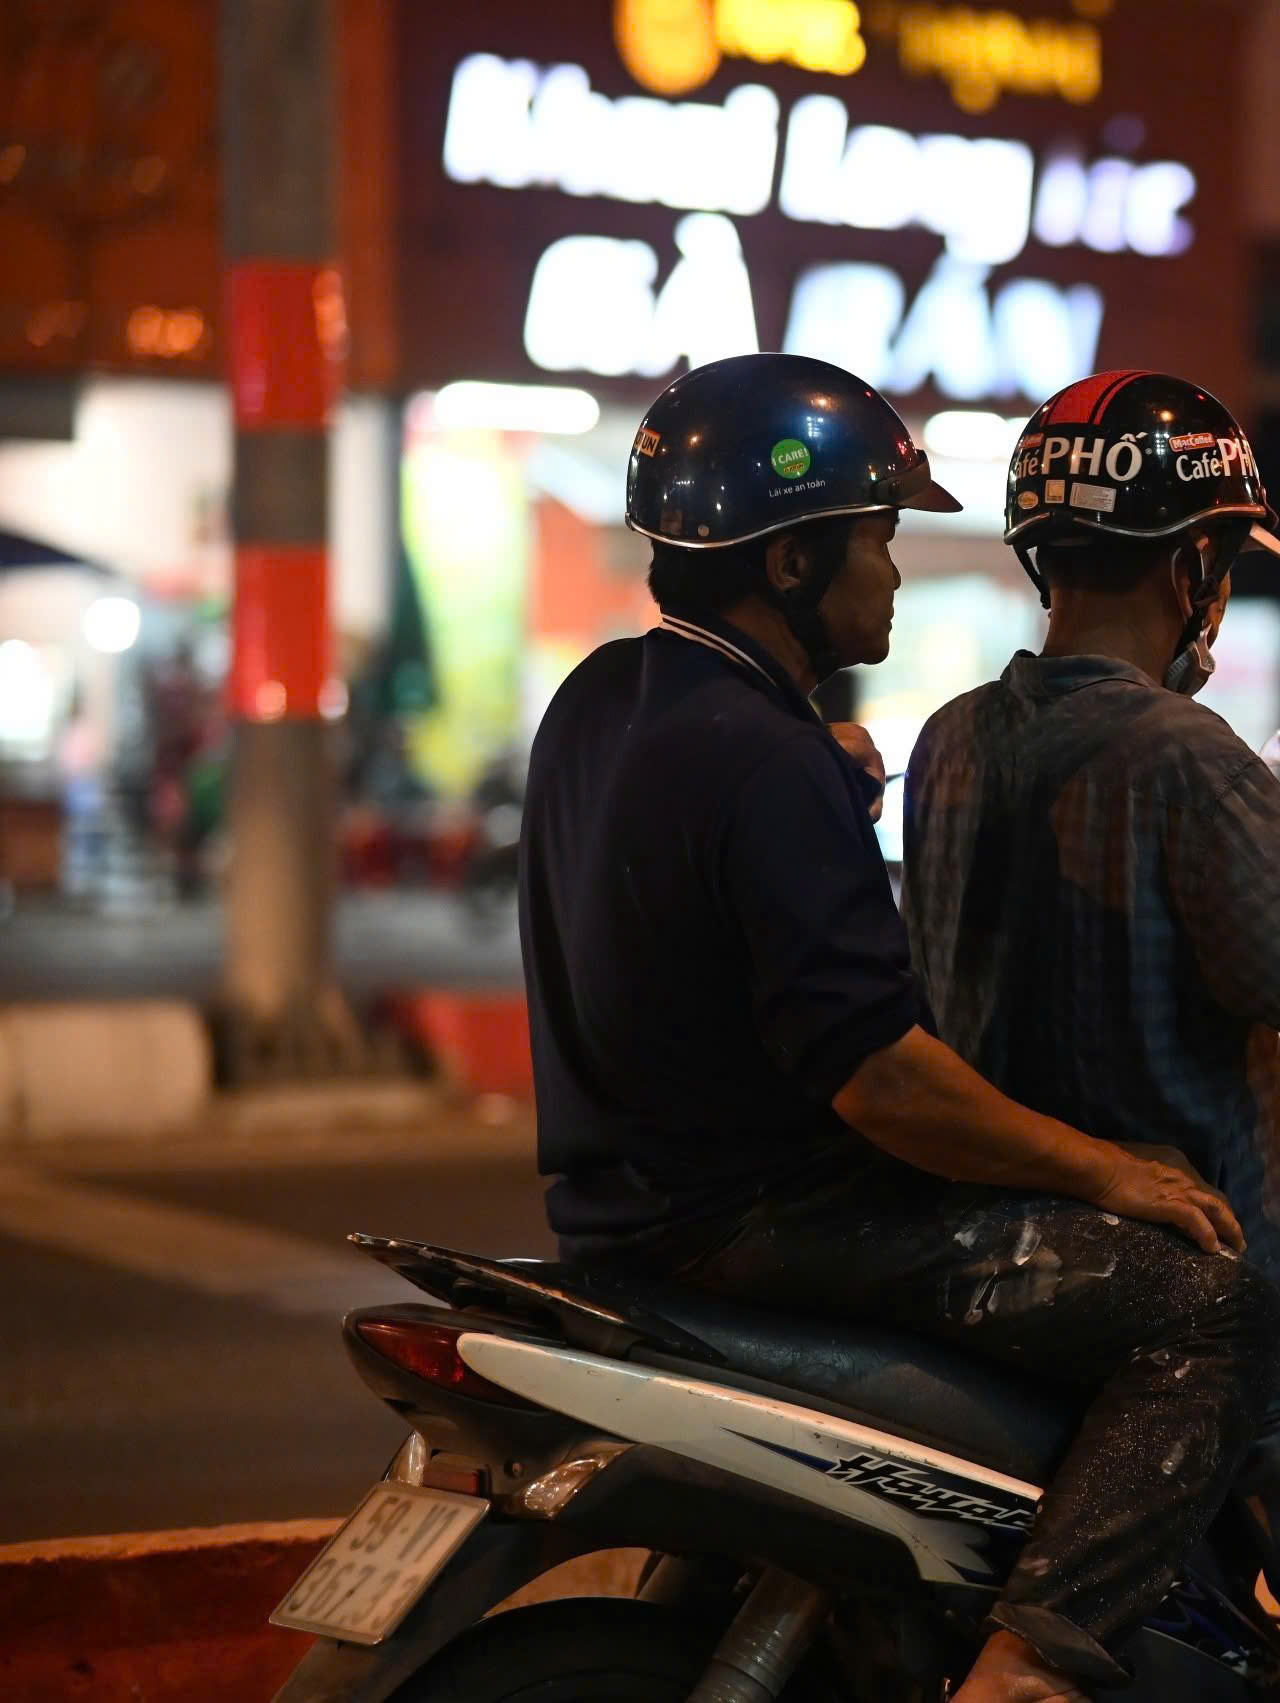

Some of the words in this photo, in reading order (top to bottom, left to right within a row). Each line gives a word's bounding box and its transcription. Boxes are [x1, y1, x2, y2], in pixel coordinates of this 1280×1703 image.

[778, 447, 809, 465] CARE!
[1176, 449, 1222, 482] Café
[1216, 437, 1255, 477] PH
[783, 486, 793, 495] xe
[795, 483, 806, 492] an
